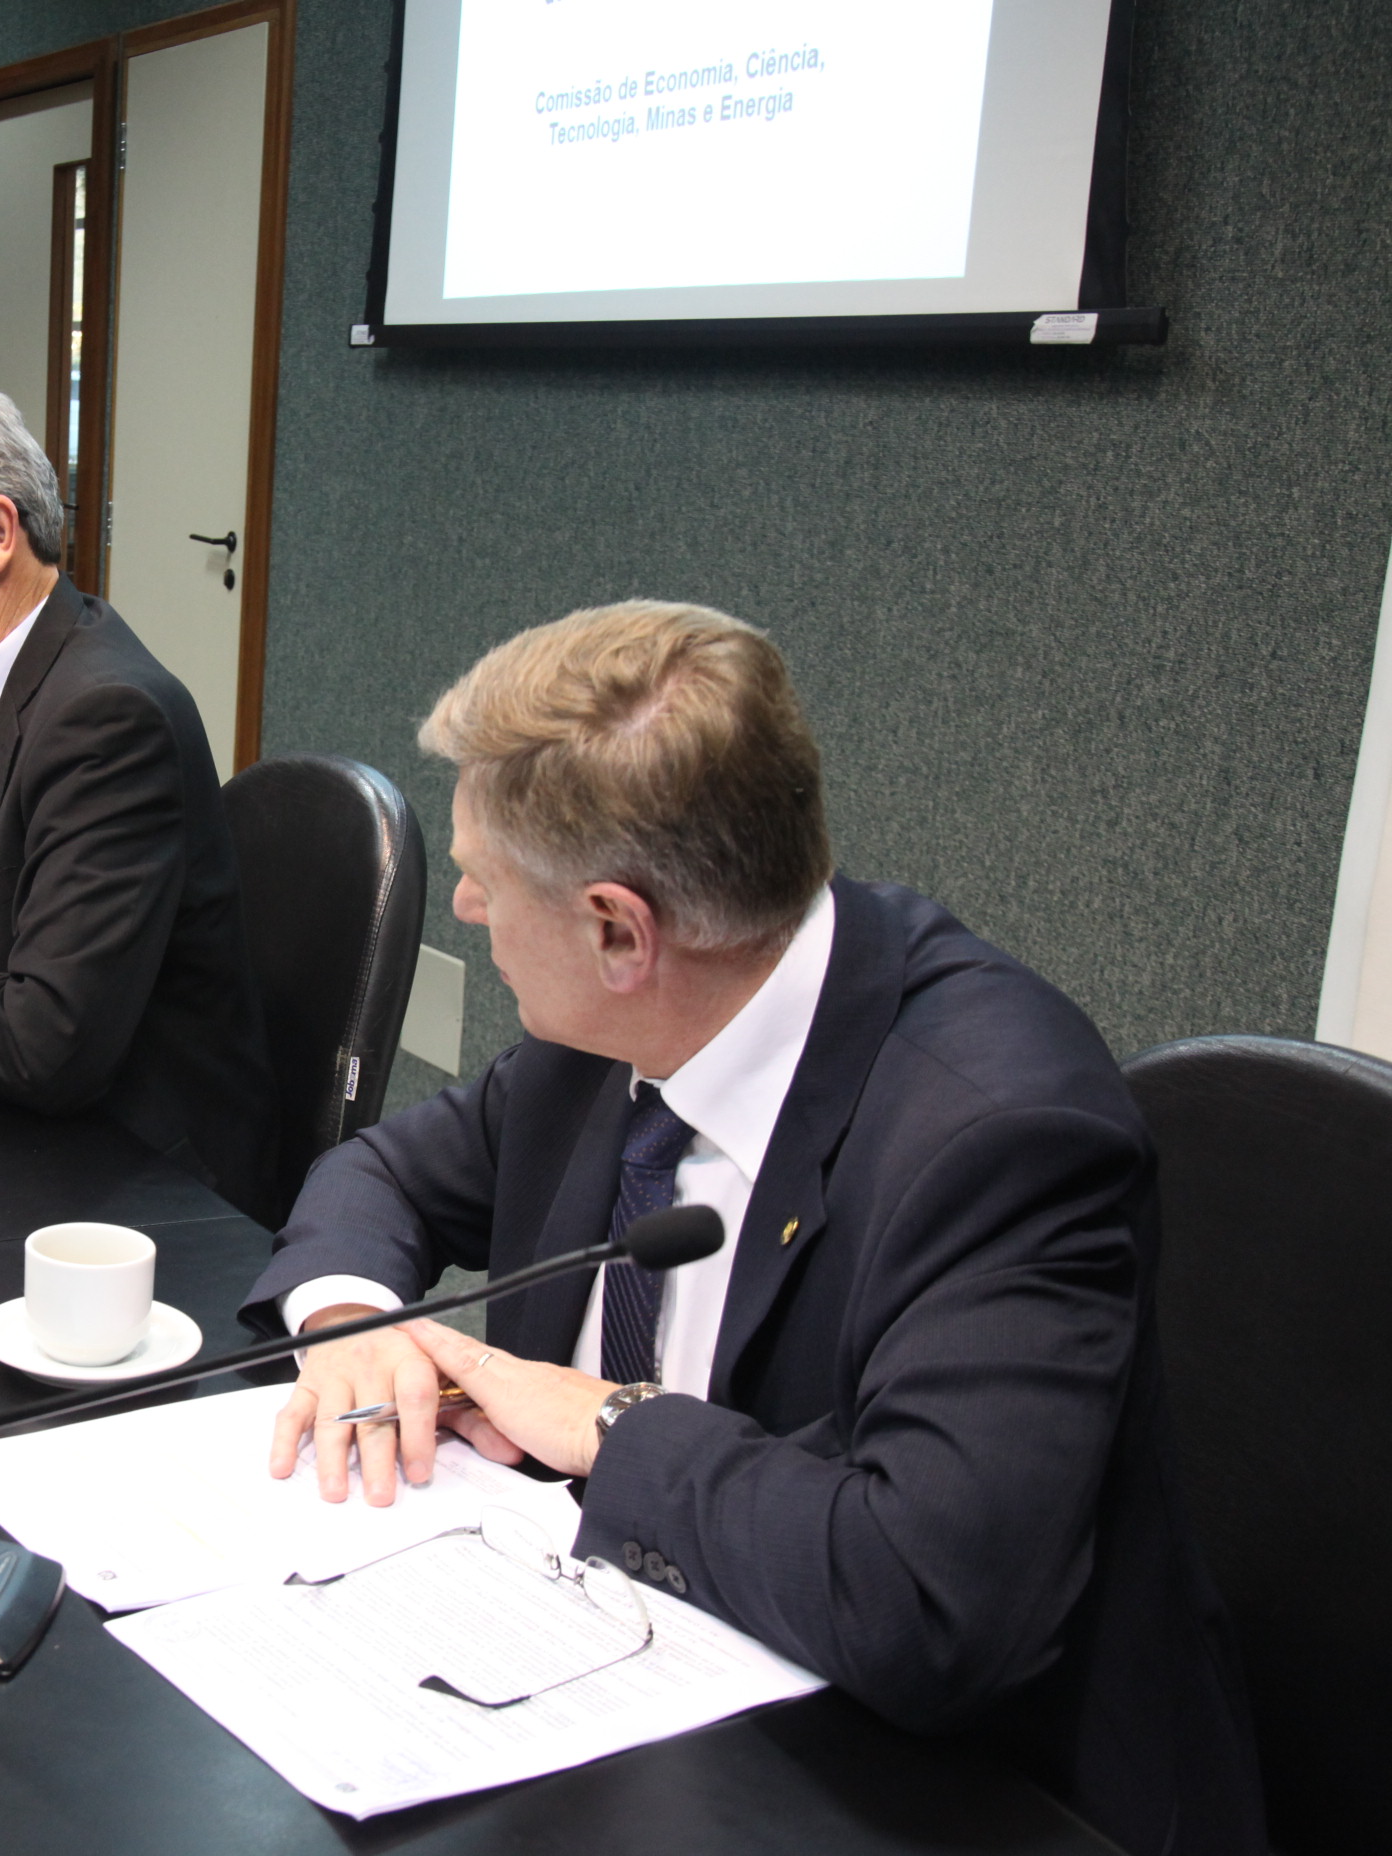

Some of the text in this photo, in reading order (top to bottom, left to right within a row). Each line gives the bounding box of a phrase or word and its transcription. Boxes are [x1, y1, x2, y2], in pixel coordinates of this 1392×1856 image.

[535, 43, 826, 114] Comissão de Economia, Ciência,
[549, 86, 794, 145] Tecnologia, Minas e Energia
